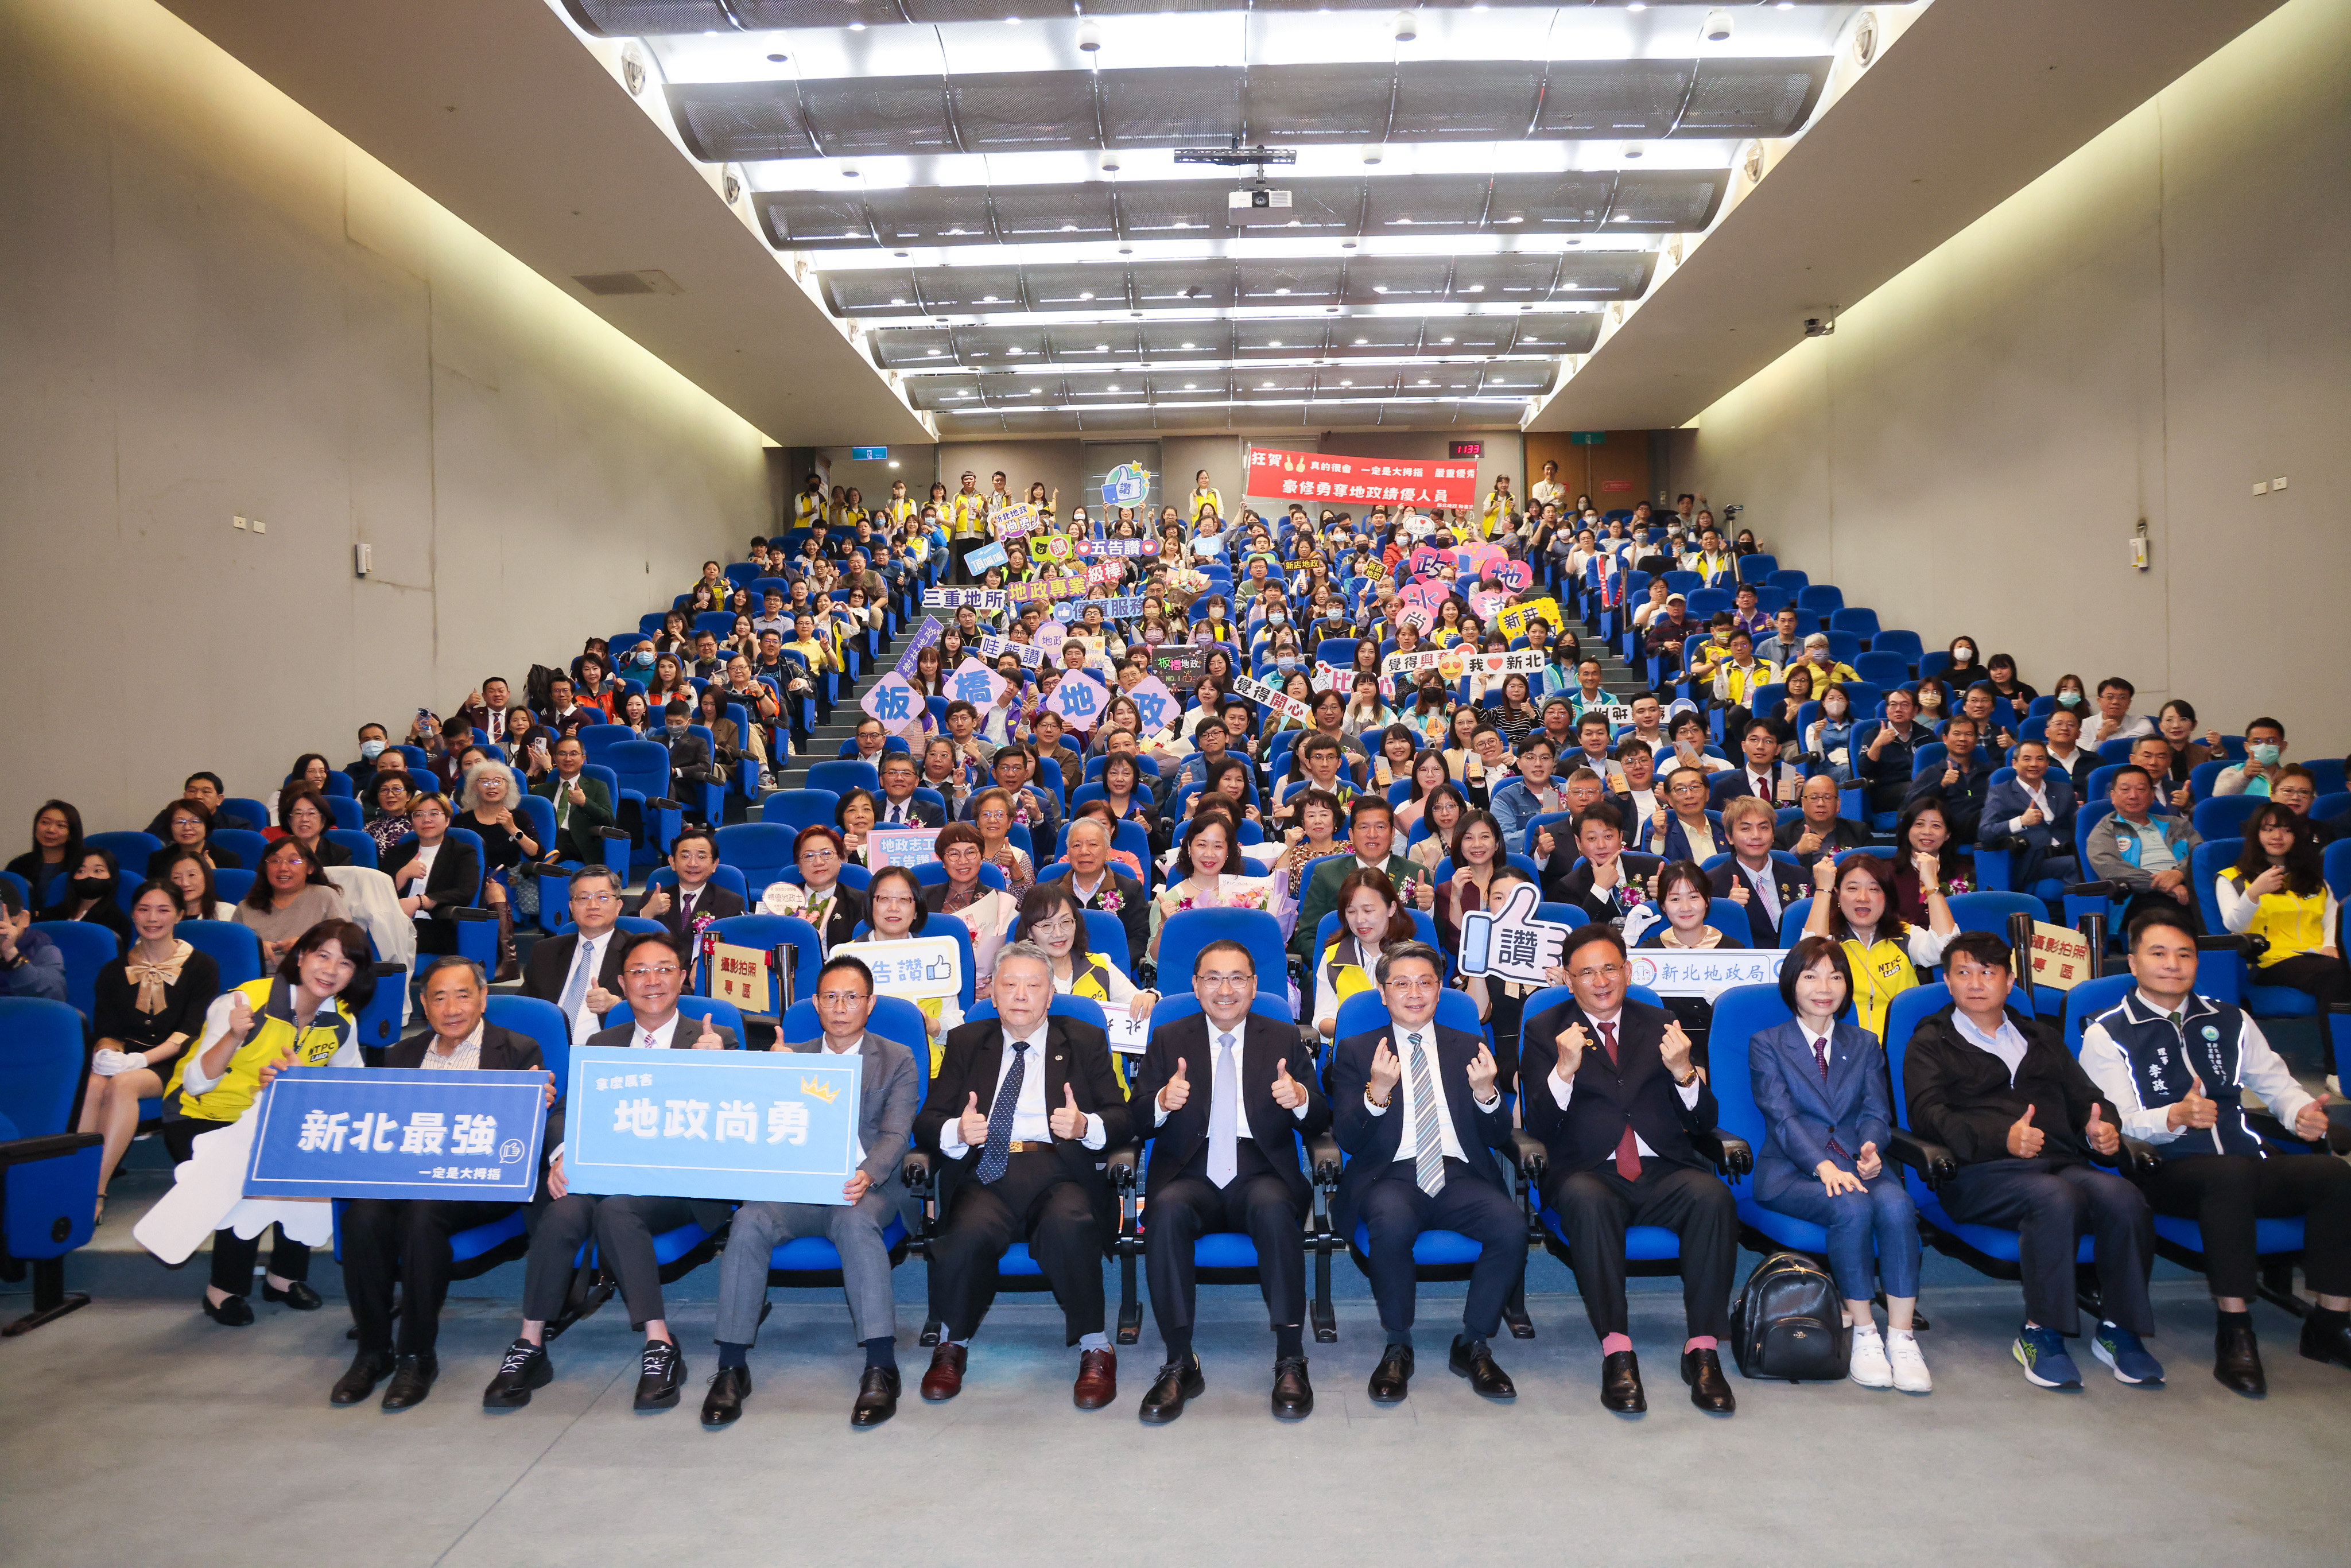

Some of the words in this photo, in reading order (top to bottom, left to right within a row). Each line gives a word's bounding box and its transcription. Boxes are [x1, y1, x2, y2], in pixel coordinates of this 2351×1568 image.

[1251, 451, 1282, 467] 狂賀
[1310, 461, 1351, 474] 真的很會
[1361, 465, 1423, 478] 一定是大拇指
[1119, 483, 1131, 495] 讚
[1282, 479, 1448, 503] 豪修勇奪地政績優人員
[1052, 540, 1067, 554] 讚
[1091, 540, 1141, 556] 五告讚
[1084, 562, 1122, 583] 級棒
[1285, 559, 1319, 570] 新店地政
[1365, 569, 1381, 581] 地政
[1368, 561, 1384, 574] 新店
[924, 590, 1003, 608] 三重地所
[1009, 576, 1087, 601] 地政專業
[1157, 657, 1199, 671] 板橋地政
[1469, 658, 1484, 672] 我
[1507, 654, 1542, 669] 新北
[955, 669, 992, 705] 橋
[1332, 672, 1392, 695] 比心
[875, 685, 910, 720] 板
[1059, 682, 1096, 716] 地
[1235, 677, 1303, 717] 覺得開心
[1132, 692, 1166, 728] 政
[881, 837, 935, 852] 地政志工
[1498, 928, 1538, 969] 讚
[2032, 934, 2088, 961] 攝影拍照
[721, 957, 756, 978] 攝影拍照
[1662, 963, 1764, 983] 新北地政局
[1884, 965, 1900, 977] LAND
[2032, 957, 2075, 980] 專區
[724, 980, 751, 999] 專區
[311, 1053, 328, 1061] LAND
[297, 1109, 498, 1156] 新北最強
[613, 1097, 810, 1147] 地政尚勇
[418, 1167, 501, 1181] 一定是大拇指
